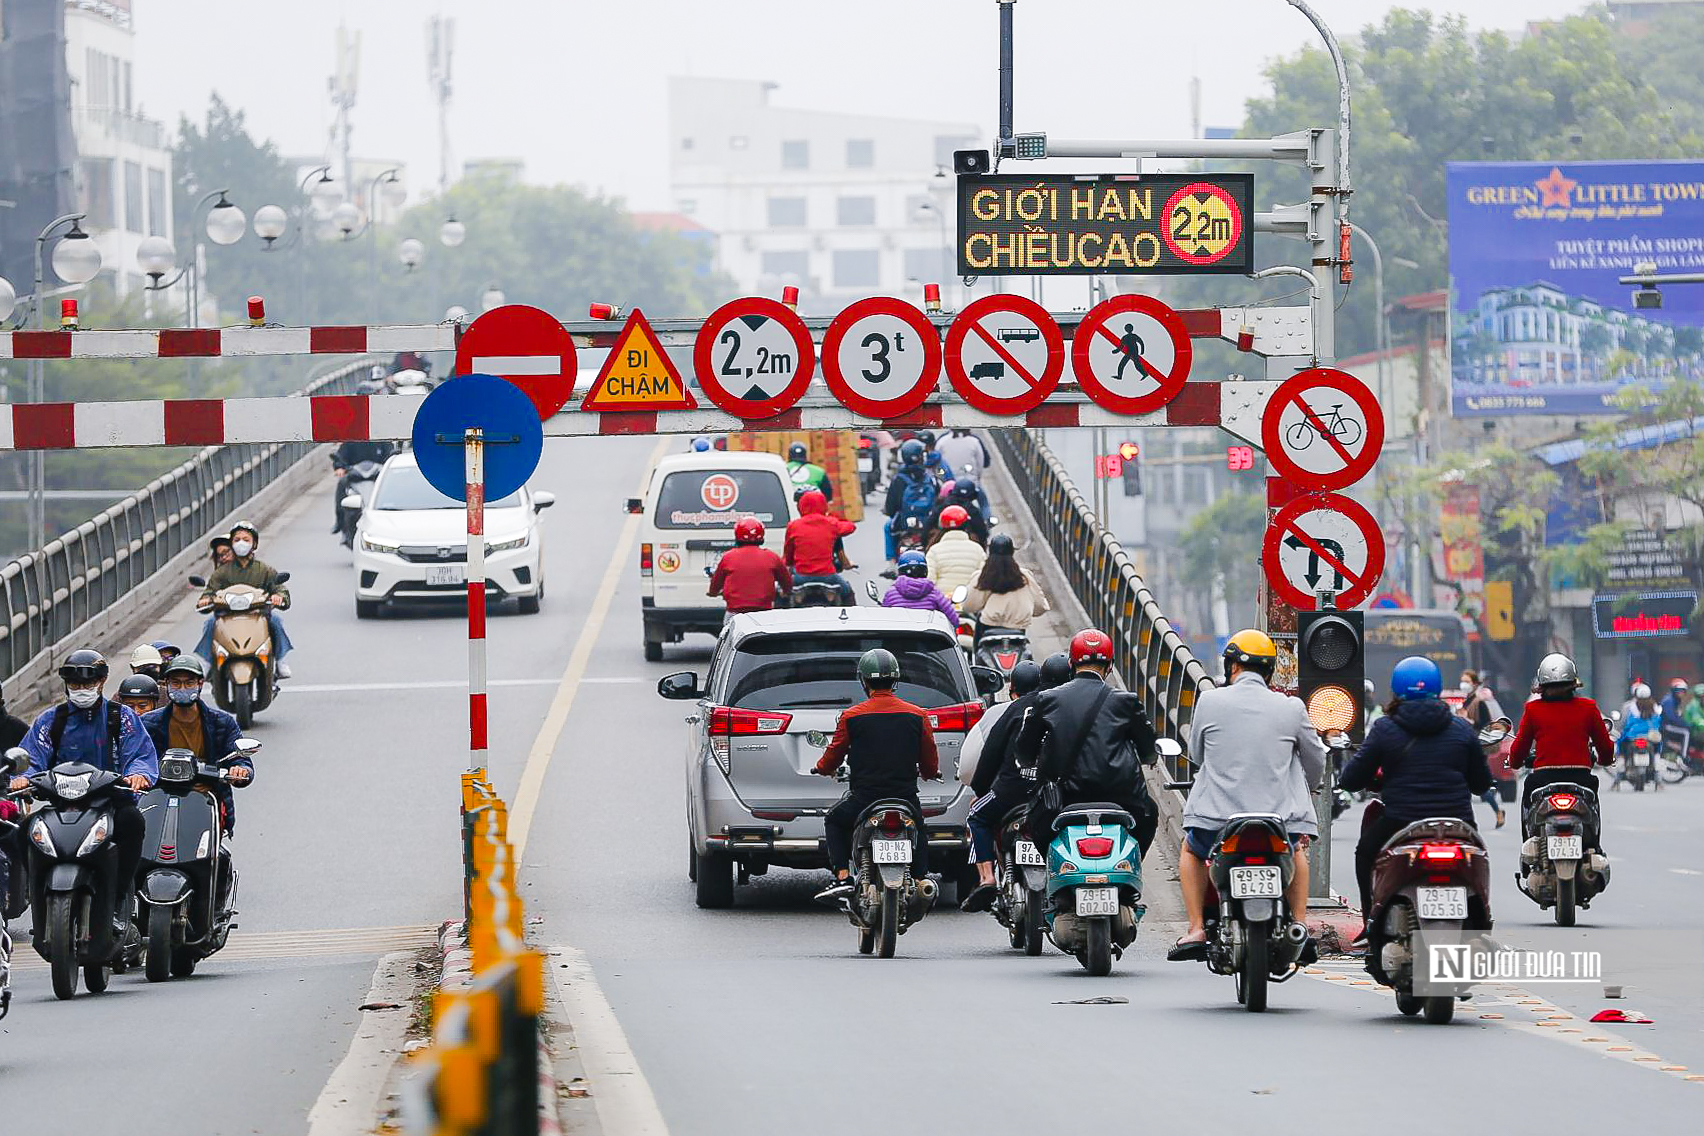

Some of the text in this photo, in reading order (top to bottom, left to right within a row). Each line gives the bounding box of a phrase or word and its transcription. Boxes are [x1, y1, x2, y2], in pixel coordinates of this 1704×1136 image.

[972, 183, 1152, 222] GIỚI HẠN
[1467, 186, 1538, 204] GREEN
[1576, 184, 1647, 203] LITTLE
[1172, 207, 1230, 245] 2,2m
[627, 349, 647, 368] ĐI
[720, 330, 791, 379] 2,2m
[606, 372, 670, 401] CHẬM
[1228, 446, 1253, 470] 39
[880, 852, 906, 861] 4683
[1551, 848, 1579, 857] 074.34
[1082, 890, 1111, 900] 29-E1
[1241, 882, 1274, 894] 8429
[1422, 904, 1464, 916] 025.36
